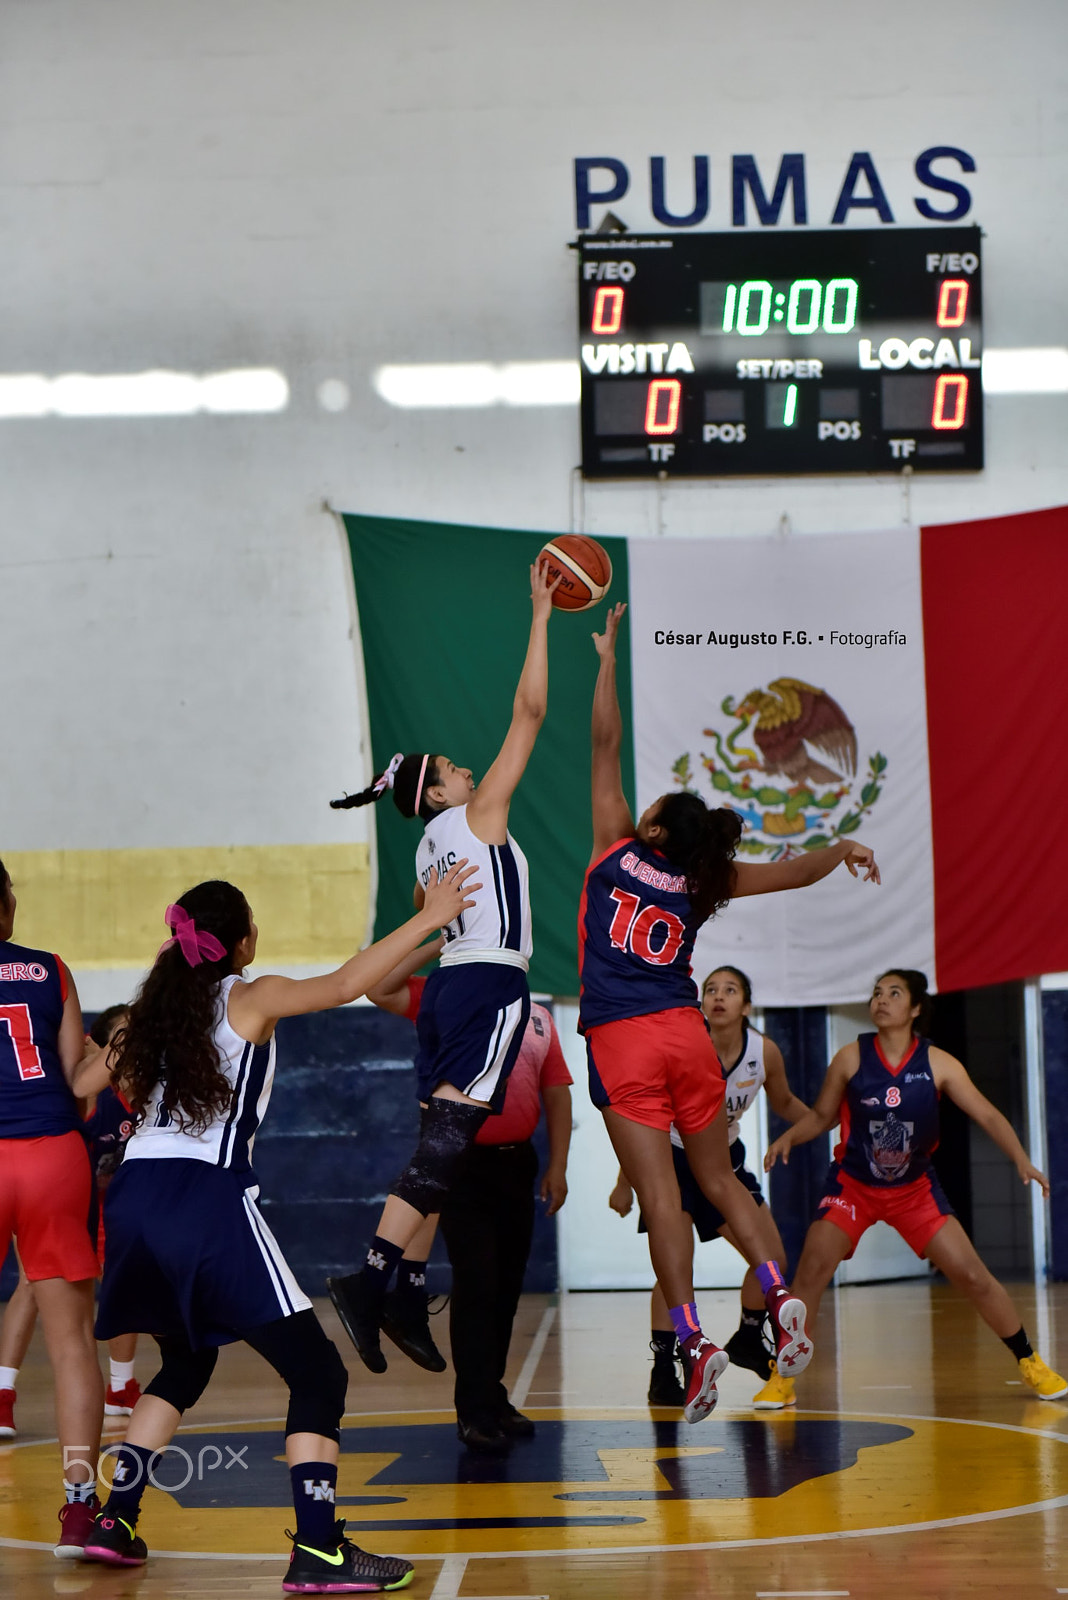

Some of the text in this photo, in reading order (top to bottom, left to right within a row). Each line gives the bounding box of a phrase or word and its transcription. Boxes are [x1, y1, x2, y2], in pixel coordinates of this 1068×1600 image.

[573, 146, 977, 230] PUMAS
[583, 261, 636, 281] F/EQ
[926, 253, 979, 273] F/EQ
[591, 286, 624, 334] 0
[722, 278, 859, 336] 10:00
[937, 279, 969, 328] 0
[582, 342, 695, 373] VISITA
[858, 338, 981, 369] LOCAL
[737, 359, 823, 380] SET/PER
[645, 379, 681, 435] 0
[783, 384, 798, 426] 1
[932, 374, 969, 430] 0
[704, 424, 746, 444] POS
[818, 421, 861, 441] POS
[648, 443, 676, 462] TF
[889, 439, 916, 457] TF
[620, 851, 697, 894] GUERRER
[609, 886, 686, 966] 10
[885, 1086, 901, 1108] 8
